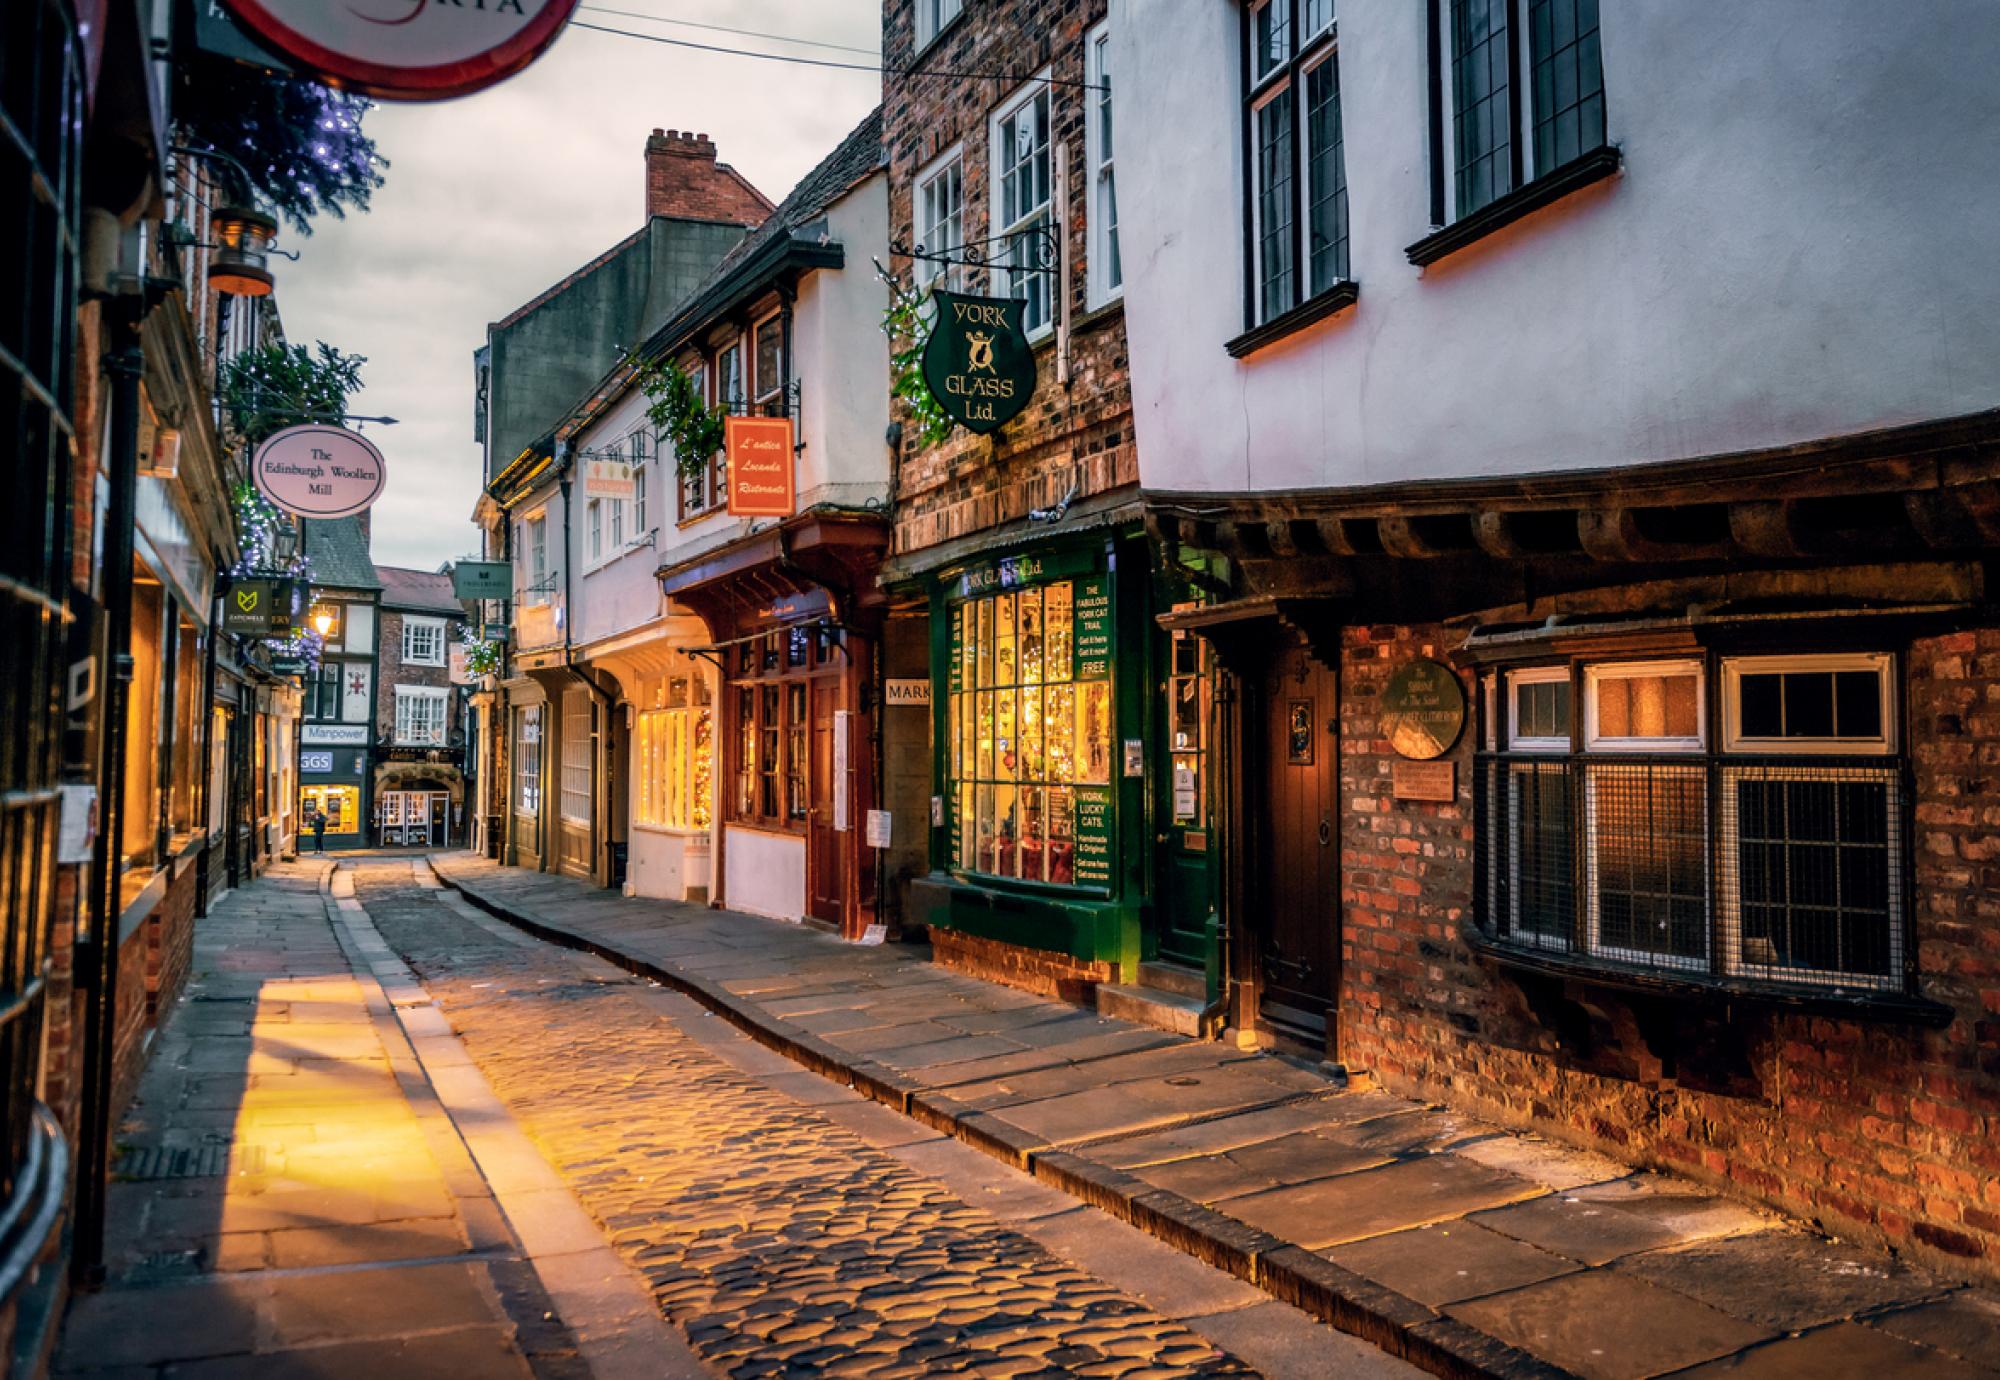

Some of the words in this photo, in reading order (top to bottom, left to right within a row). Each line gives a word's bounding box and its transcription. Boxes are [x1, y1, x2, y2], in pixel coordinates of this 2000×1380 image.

[952, 302, 1011, 330] YORK
[945, 375, 1015, 399] GLASS
[965, 400, 997, 420] Ltd.
[310, 448, 333, 460] The
[264, 462, 325, 479] Edinburgh
[331, 465, 376, 480] Woollen
[308, 484, 333, 496] Mill
[1082, 661, 1105, 673] FREE
[308, 727, 364, 740] Manpower
[1082, 792, 1104, 802] YORK
[1080, 804, 1105, 815] LUCKY
